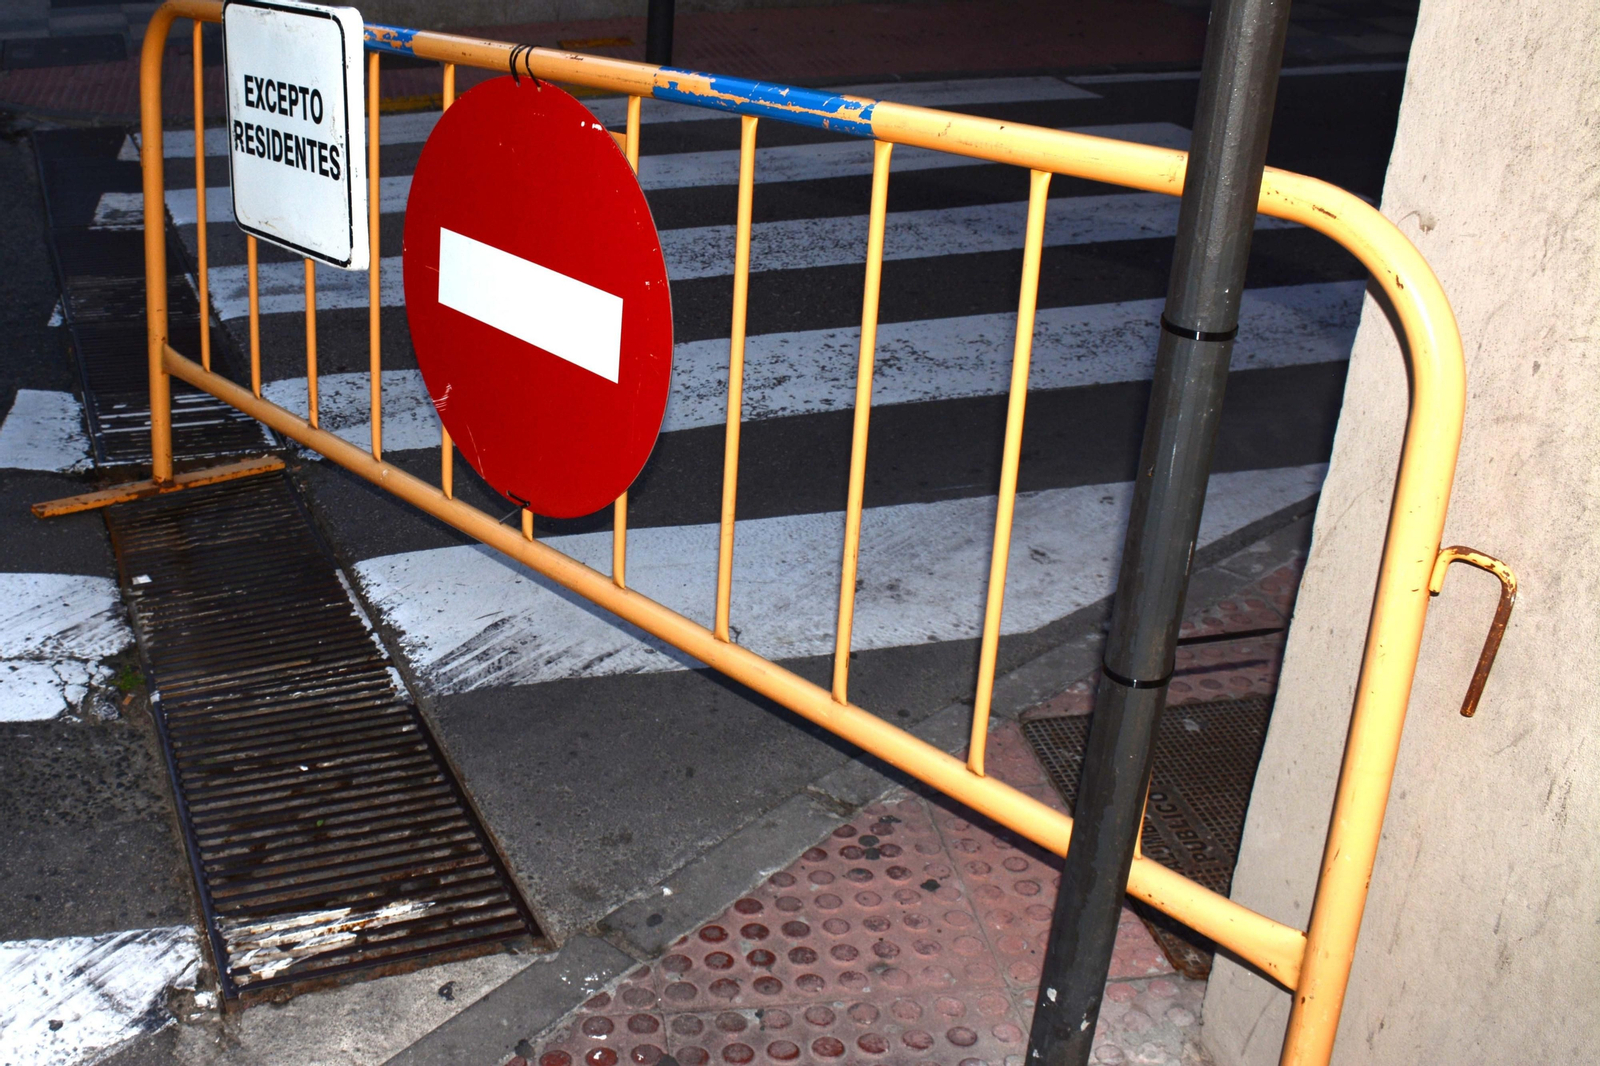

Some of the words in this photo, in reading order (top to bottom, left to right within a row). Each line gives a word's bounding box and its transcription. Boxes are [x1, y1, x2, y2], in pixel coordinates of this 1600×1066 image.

[244, 74, 323, 125] EXCEPTO
[234, 119, 341, 181] RESIDENTES
[1142, 814, 1185, 870] ALUMB
